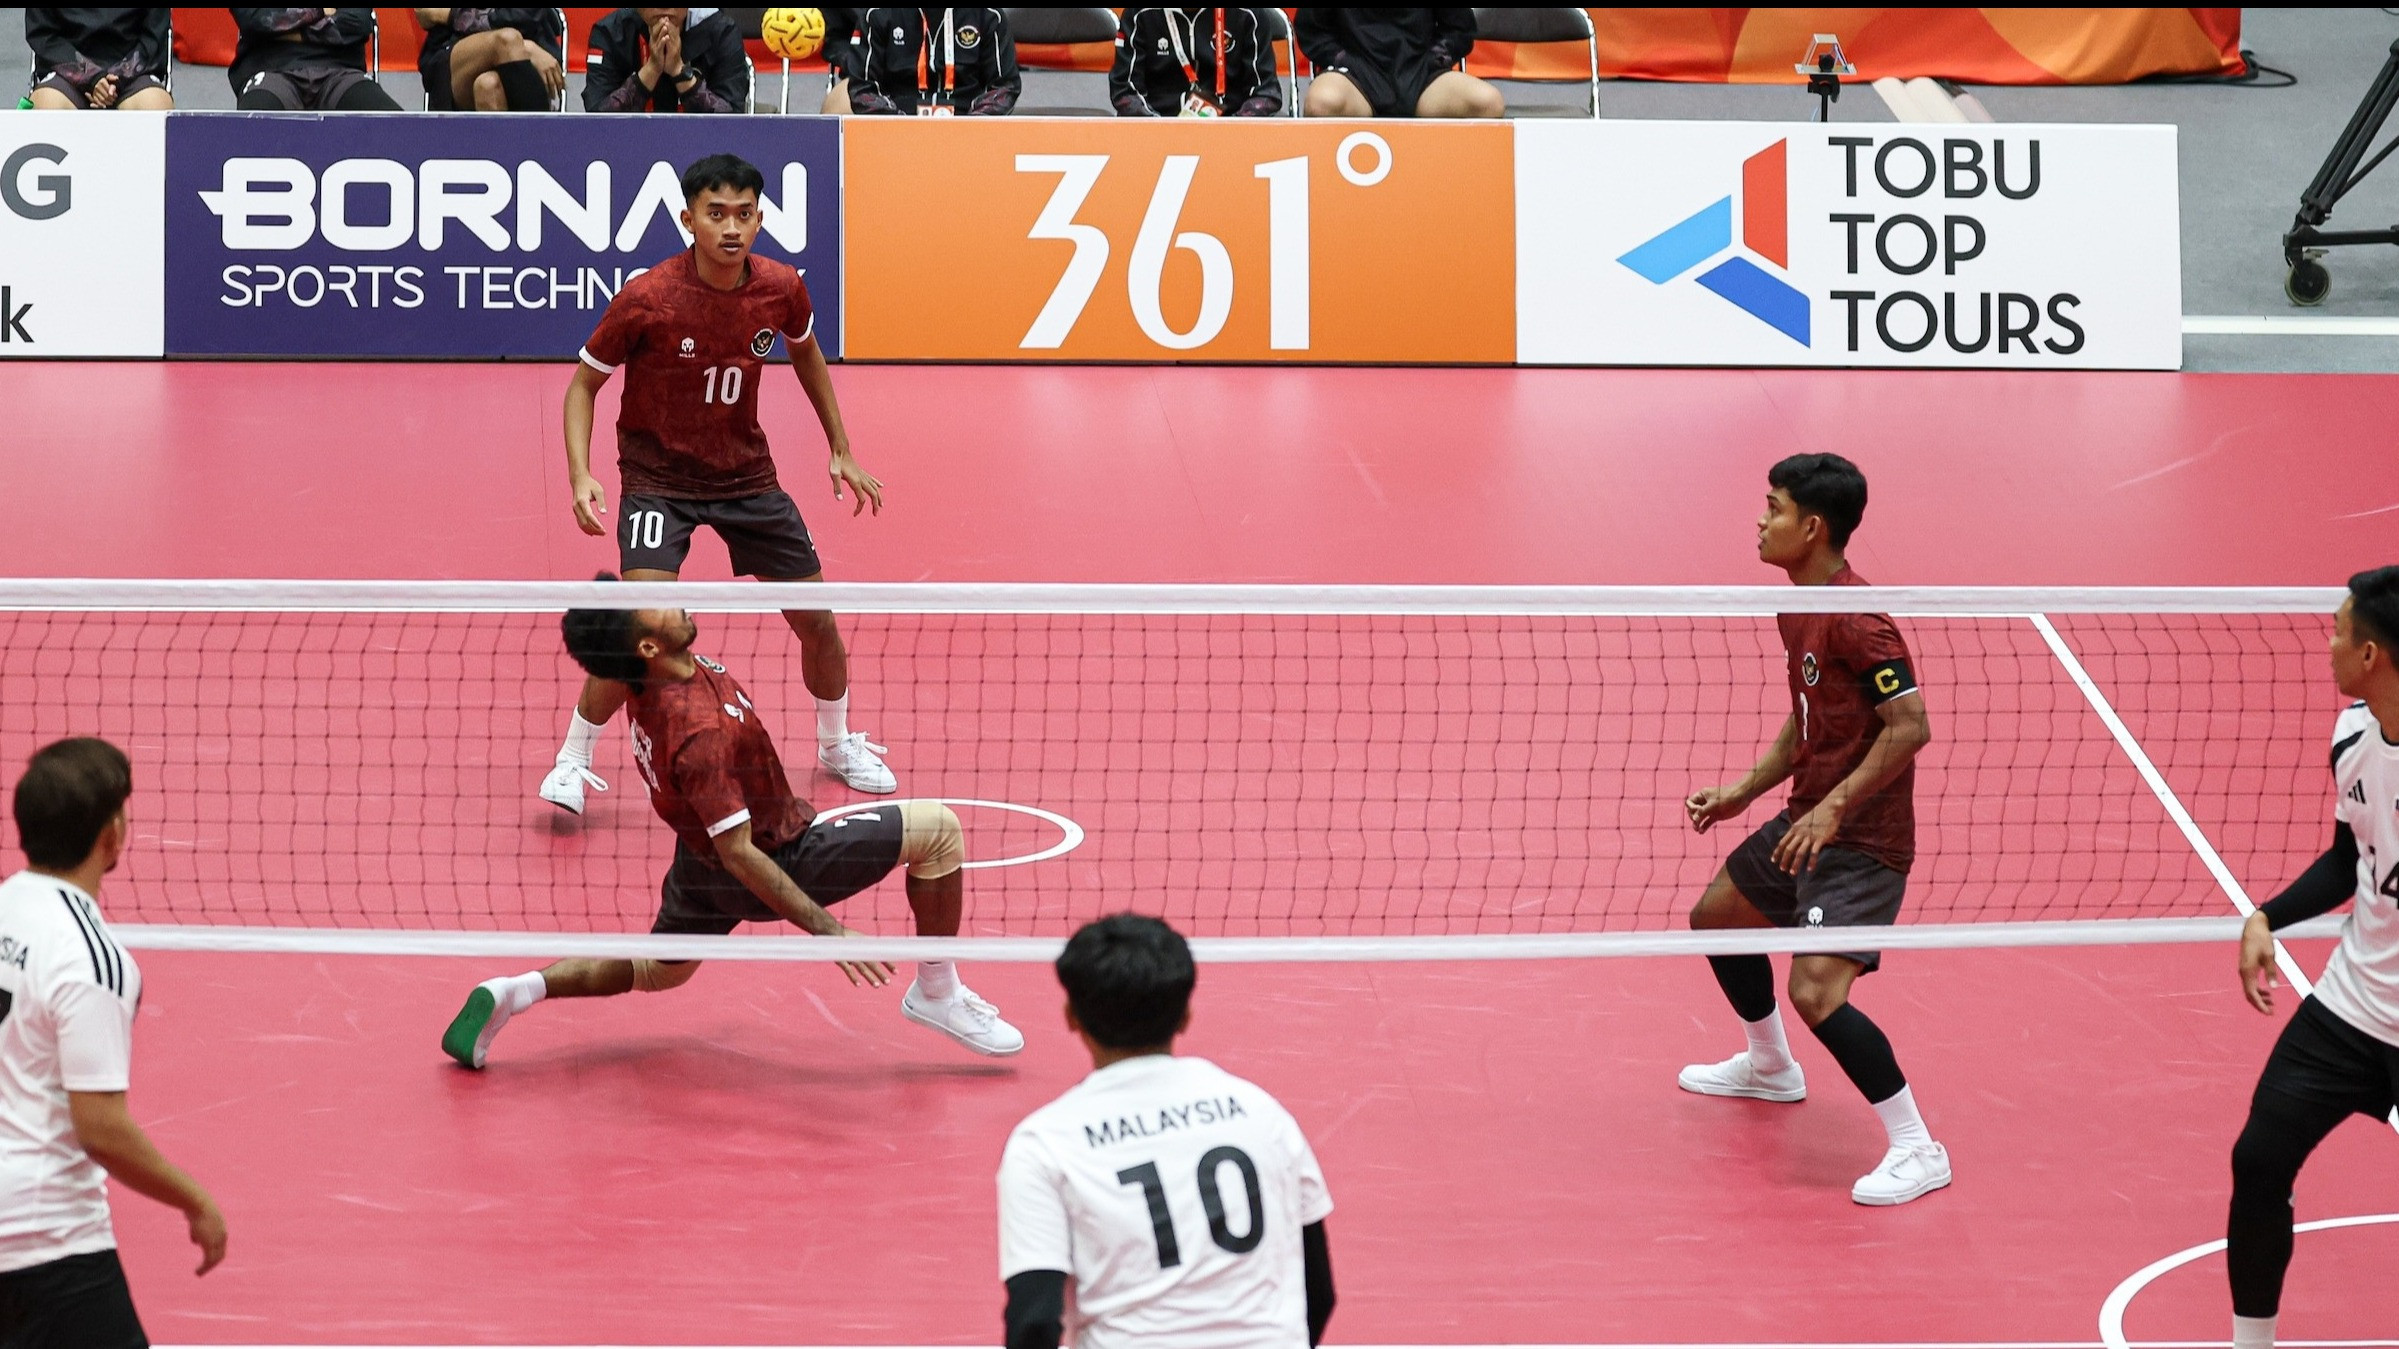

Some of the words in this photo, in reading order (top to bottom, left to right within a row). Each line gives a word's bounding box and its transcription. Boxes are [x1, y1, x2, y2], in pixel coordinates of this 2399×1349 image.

[1828, 136, 2041, 200] TOBU
[198, 157, 807, 254] BORNAN
[1829, 212, 1987, 275] TOP
[220, 265, 425, 308] SPORTS
[1829, 290, 2085, 355] TOURS
[703, 366, 743, 405] 10
[628, 510, 665, 549] 10
[1874, 667, 1901, 694] C
[1084, 1096, 1247, 1149] MALAYSIA
[1116, 1145, 1265, 1270] 10
